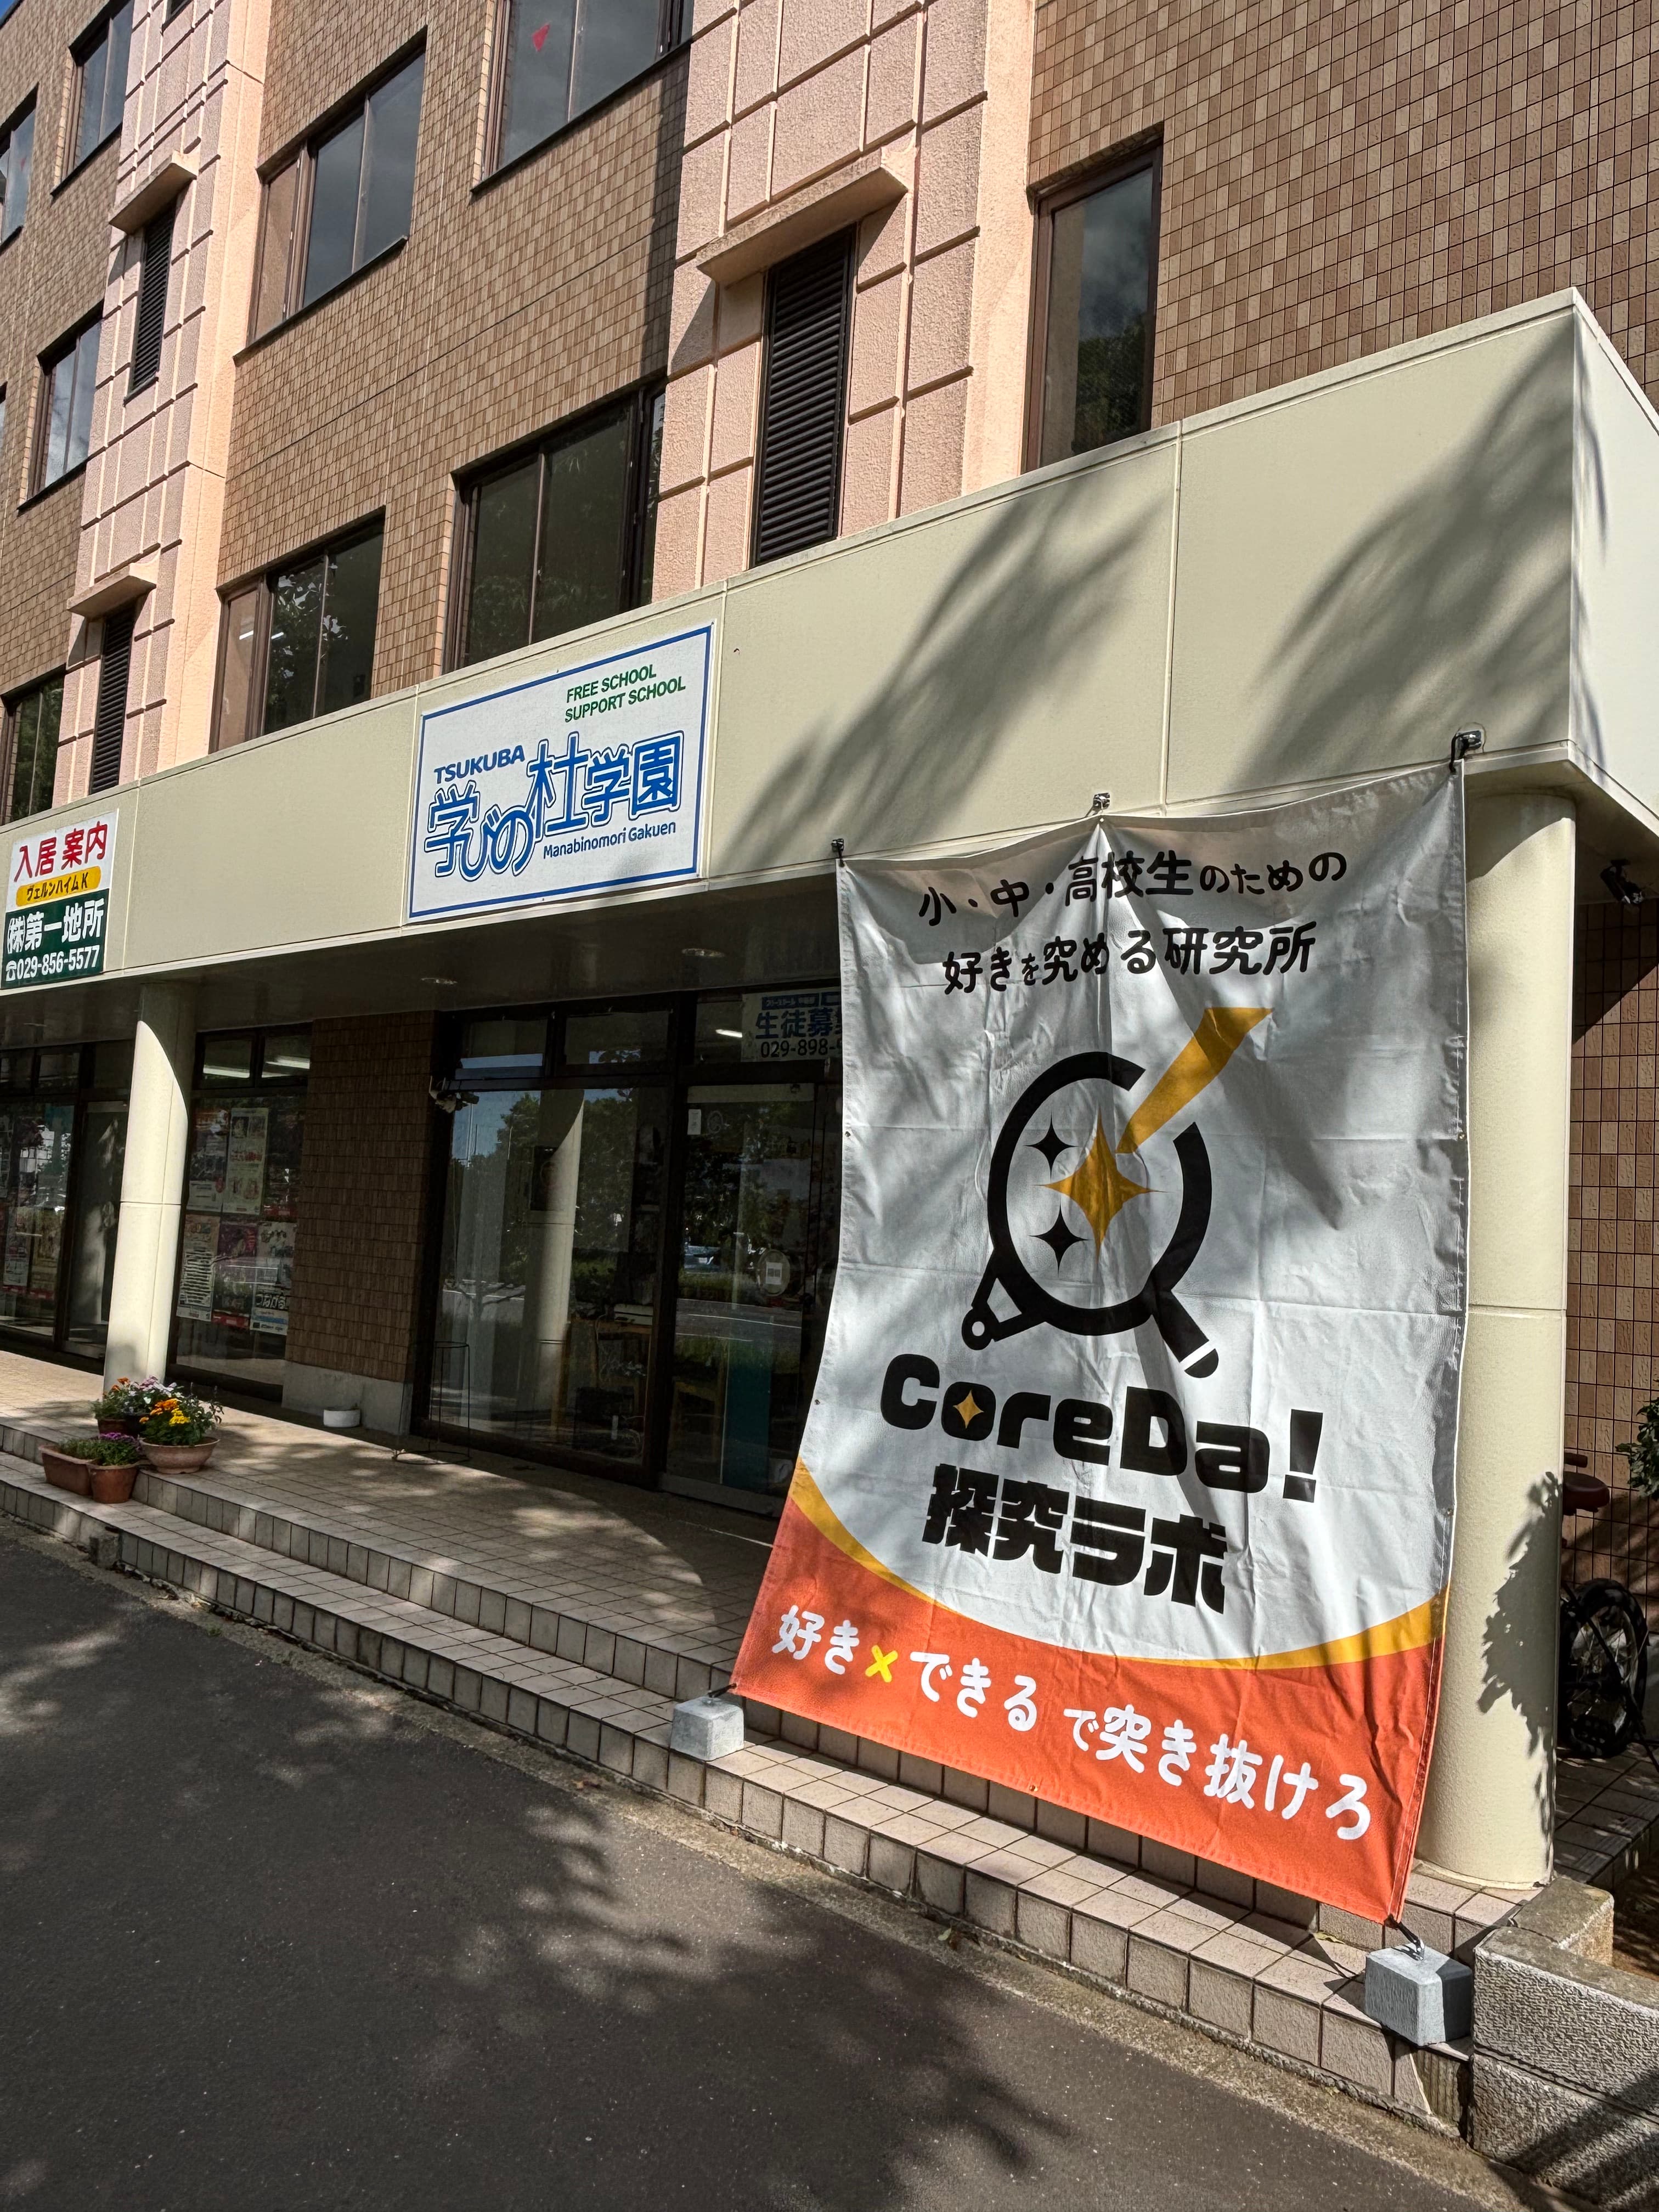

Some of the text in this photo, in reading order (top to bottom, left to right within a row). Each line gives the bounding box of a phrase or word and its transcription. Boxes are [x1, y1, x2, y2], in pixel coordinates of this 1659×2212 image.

[565, 676, 686, 723] SUPPORT SCHOOL
[566, 664, 657, 703] FREE SCHOOL
[433, 744, 525, 785] TSUKUBA
[424, 731, 684, 882] 学びの杜学園
[14, 821, 108, 883] 入居案内
[543, 821, 676, 860] Manabinomori Gakuen
[918, 850, 1347, 927] 小・中・高校生のための
[16, 945, 100, 980] 029-856-5577
[941, 921, 1317, 995] 好きを究める研究所
[755, 1007, 842, 1039] 生徒募
[880, 1353, 1324, 1503] CoreDa!
[922, 1463, 1227, 1615] 探究ラボ
